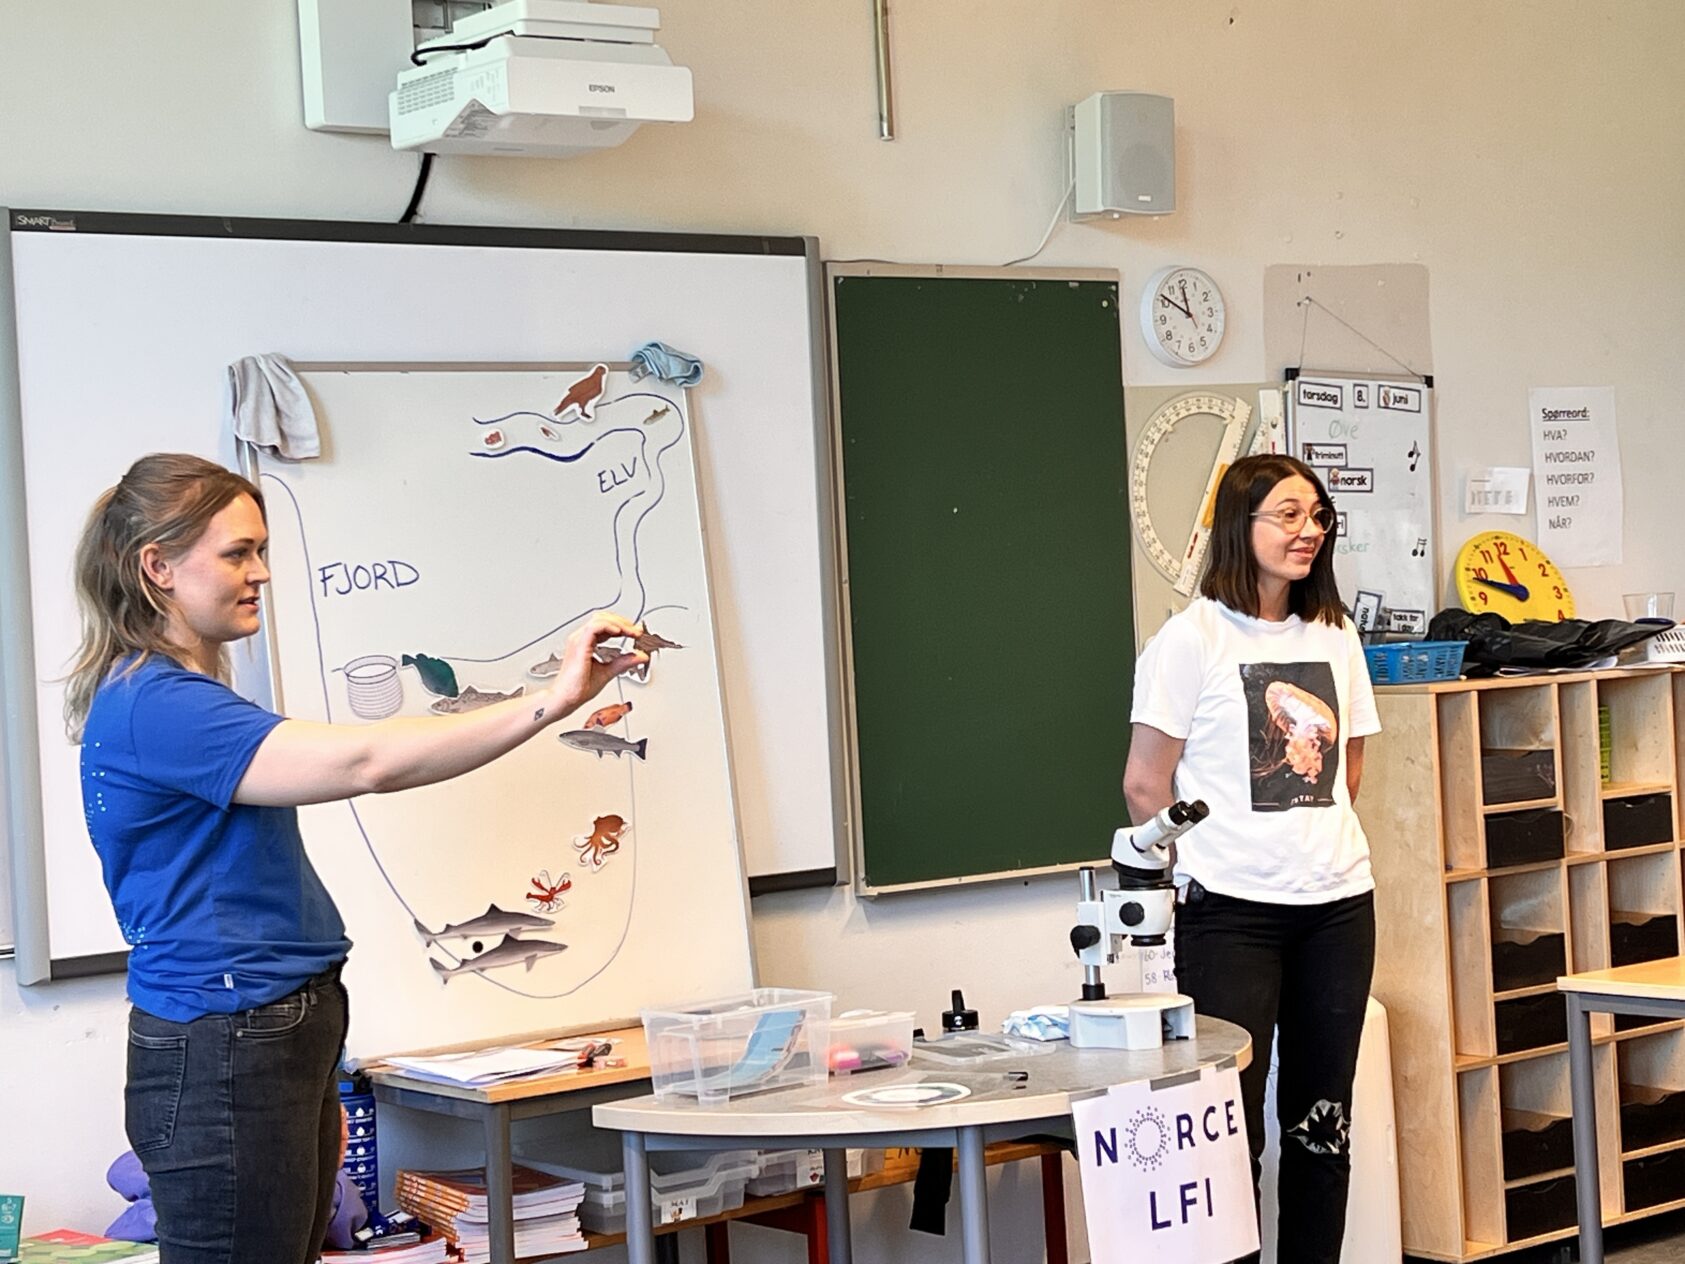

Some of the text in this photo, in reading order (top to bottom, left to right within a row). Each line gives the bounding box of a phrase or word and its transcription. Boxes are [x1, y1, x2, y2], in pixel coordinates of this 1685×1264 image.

[589, 84, 615, 93] EPSON
[1202, 292, 1208, 302] 2
[1207, 307, 1214, 318] 3
[1160, 314, 1167, 325] 9
[1206, 324, 1213, 333] 4
[1165, 330, 1173, 341] 8
[1200, 336, 1206, 347] 5
[1188, 342, 1195, 353] 6
[1303, 389, 1409, 405] torsdag 8. juni
[1542, 407, 1590, 420] Spørreord:
[1328, 420, 1359, 440] Øve
[1543, 429, 1567, 441] HVA?
[1545, 450, 1595, 463] HVORDAN?
[597, 456, 637, 493] ELV
[1340, 475, 1367, 486] norsk
[1547, 472, 1595, 485] HVORFOR?
[1548, 495, 1580, 508] HVEM?
[1549, 514, 1572, 530] NÅR?
[1493, 541, 1510, 556] 12
[1518, 547, 1528, 562] 1
[1480, 550, 1494, 564] 11
[1538, 563, 1549, 577] 2
[318, 560, 420, 598] FJORD
[1479, 592, 1488, 605] 9
[1552, 586, 1563, 600] 3
[1094, 1099, 1238, 1172] NORCE
[1150, 1177, 1213, 1231] LFI
